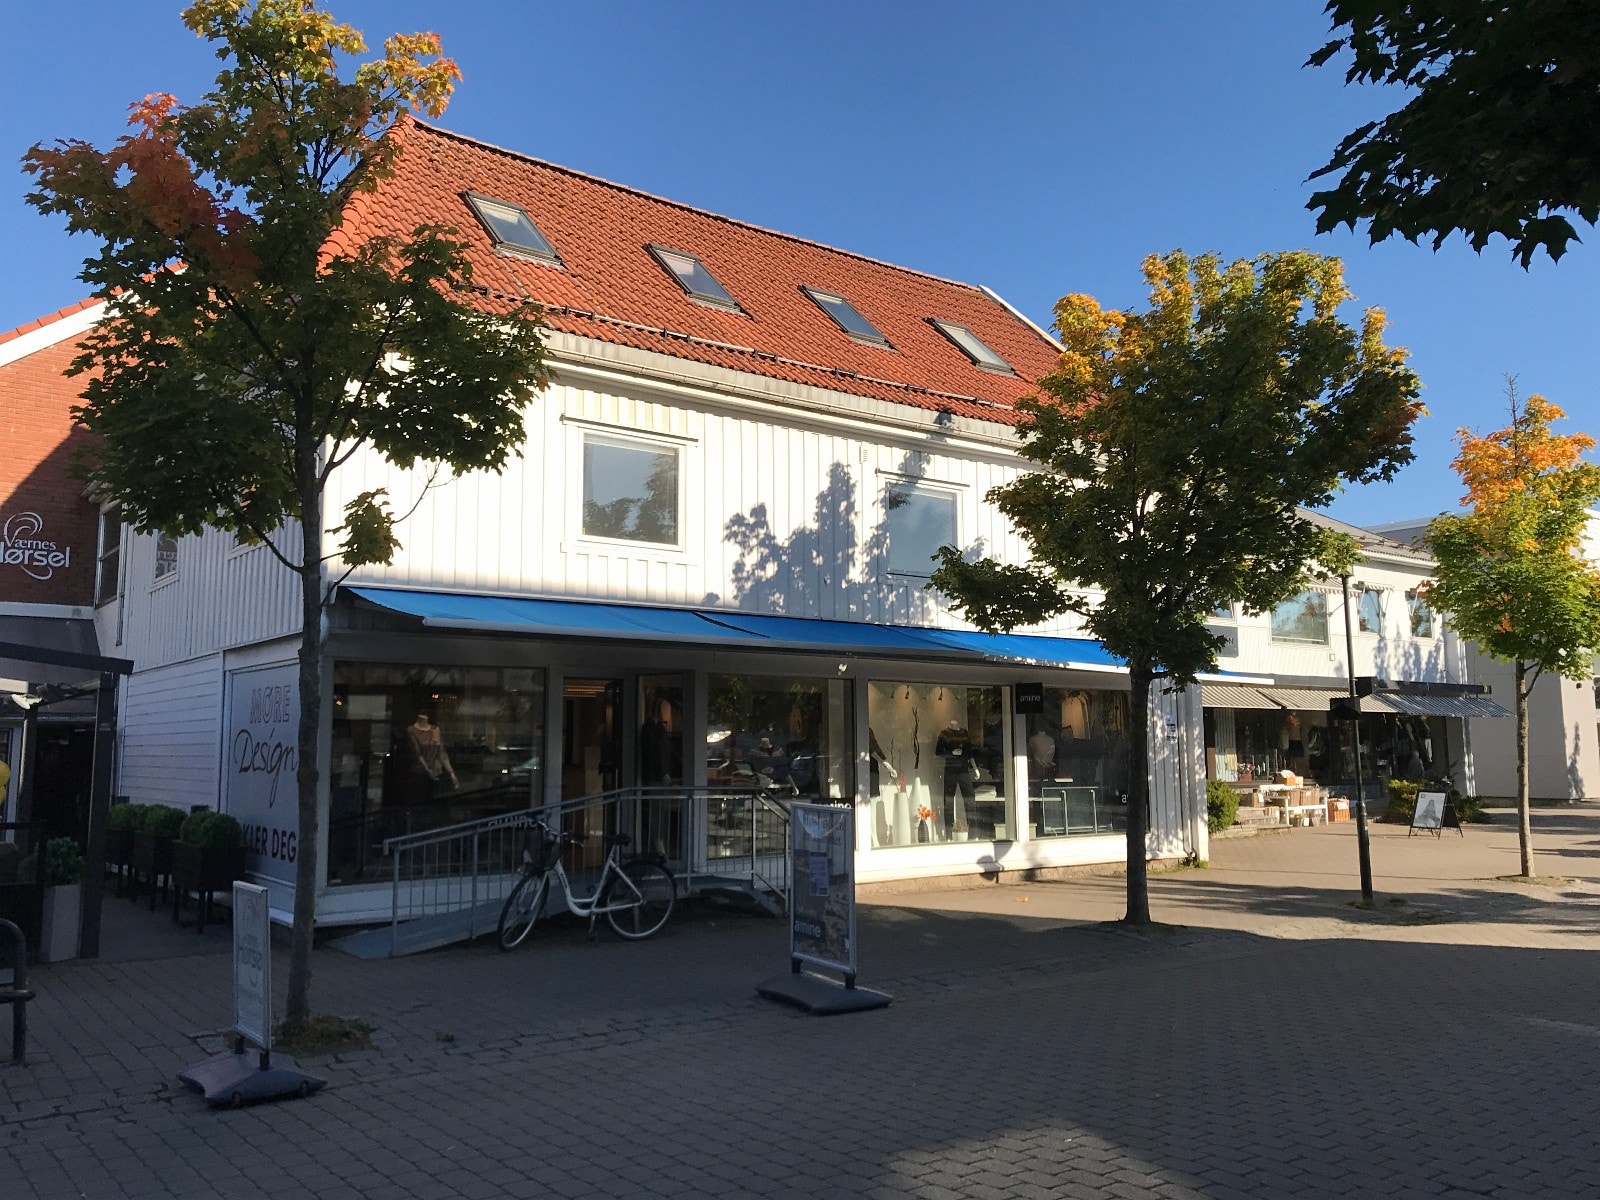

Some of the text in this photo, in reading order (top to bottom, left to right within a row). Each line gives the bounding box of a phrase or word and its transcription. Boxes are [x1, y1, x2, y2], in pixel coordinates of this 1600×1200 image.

[4, 527, 57, 551] Værnes
[1020, 694, 1041, 702] amine
[233, 728, 298, 809] Design
[272, 828, 297, 863] DEG
